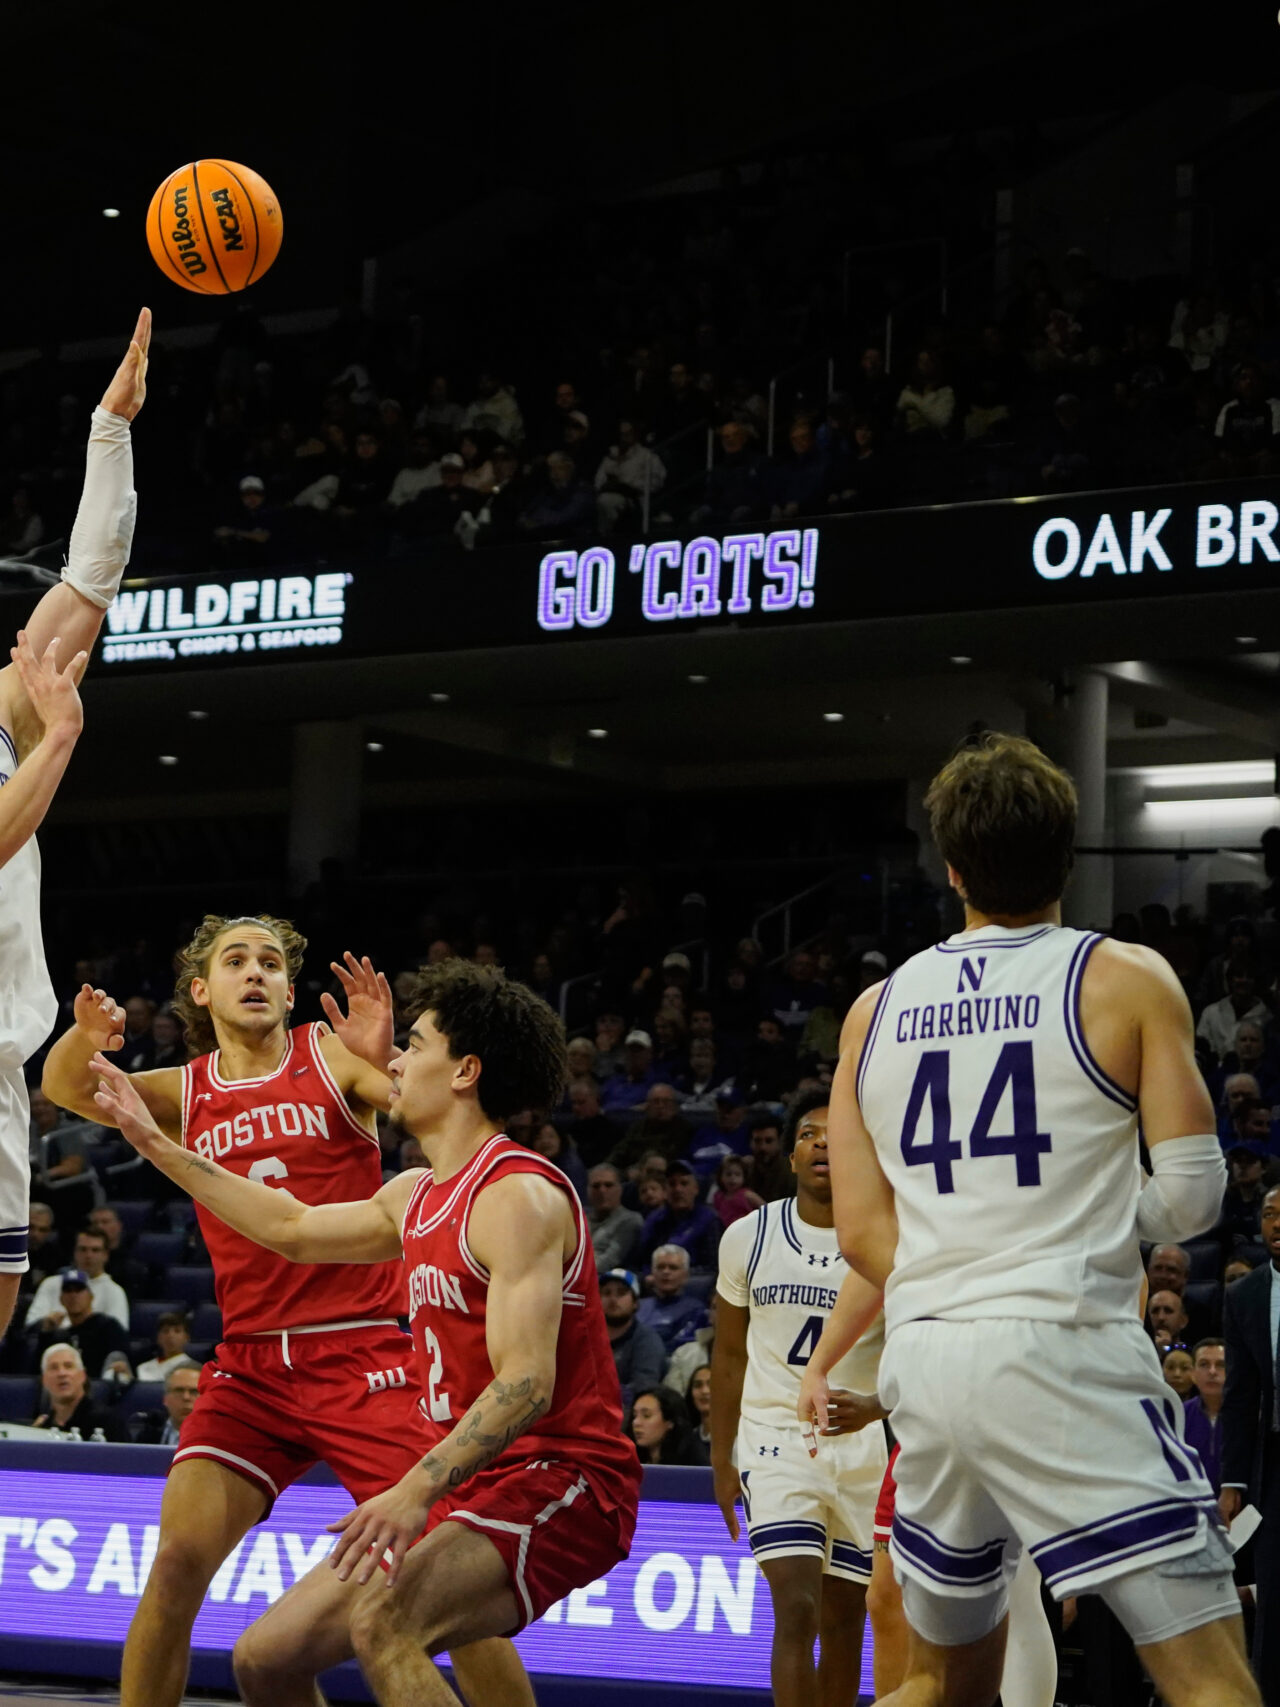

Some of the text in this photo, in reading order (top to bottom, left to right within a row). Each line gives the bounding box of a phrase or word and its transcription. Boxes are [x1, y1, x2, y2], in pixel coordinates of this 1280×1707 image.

[172, 186, 207, 277] Wilson
[210, 188, 244, 252] NCAA
[1032, 500, 1280, 581] OAK BR
[106, 572, 348, 635] WILDFIRE
[537, 528, 819, 631] GO 'CATS!
[178, 634, 240, 657] CHOPS
[240, 632, 257, 651] &
[258, 626, 344, 650] SEAFOOD
[957, 957, 987, 993] N
[896, 994, 1040, 1043] CIARAVINO
[194, 1102, 331, 1161] BOSTON
[900, 1040, 1053, 1195] 44
[752, 1284, 838, 1310] NORTHWES
[787, 1315, 824, 1367] 4
[363, 1366, 407, 1394] BU
[633, 1552, 758, 1635] ON
